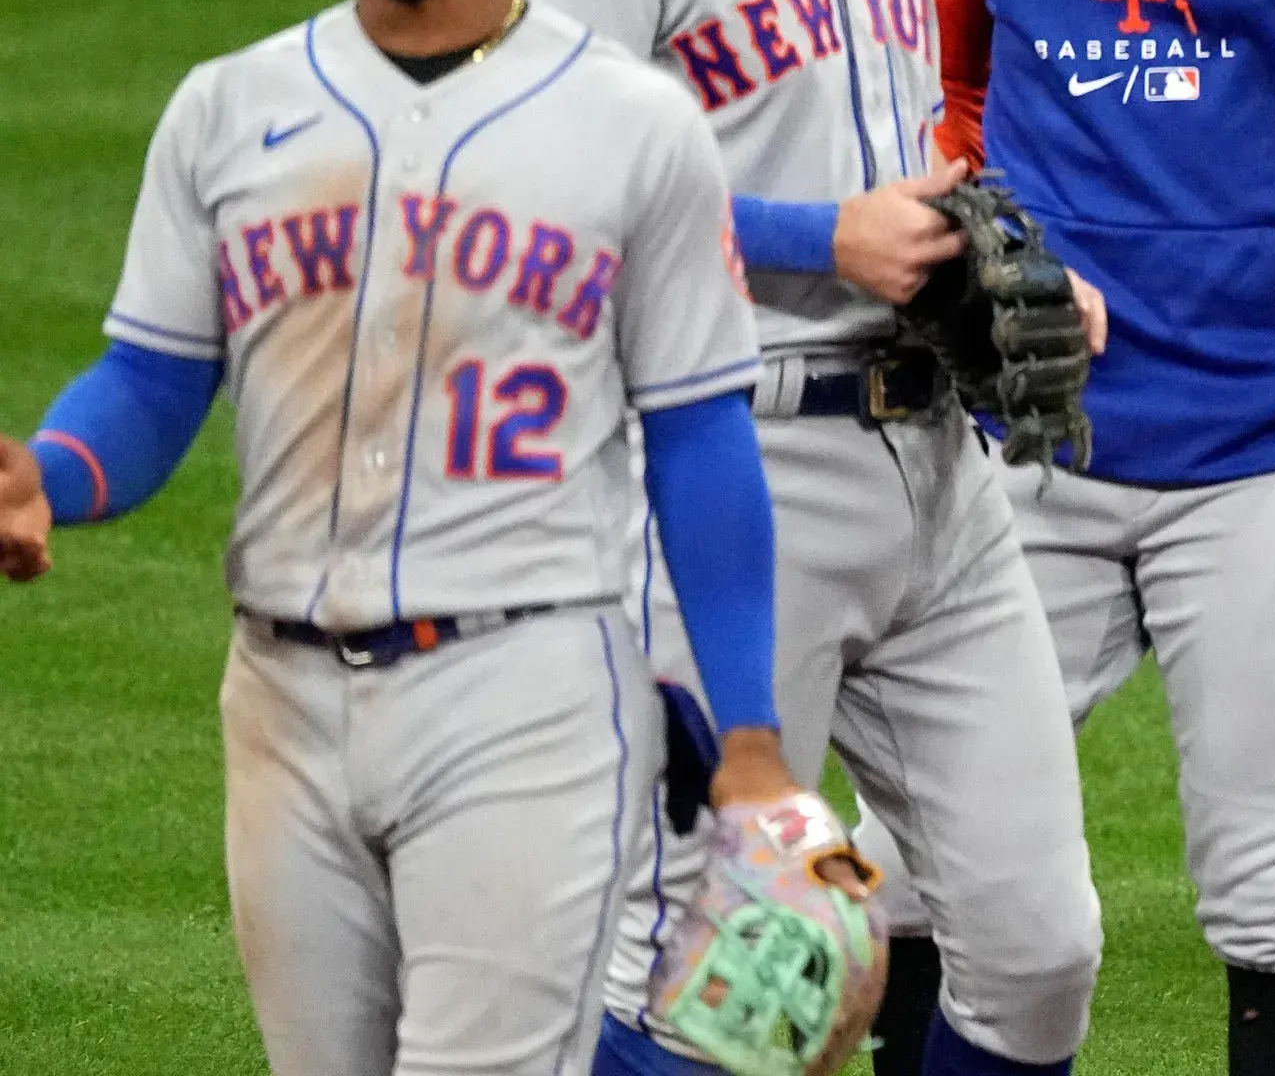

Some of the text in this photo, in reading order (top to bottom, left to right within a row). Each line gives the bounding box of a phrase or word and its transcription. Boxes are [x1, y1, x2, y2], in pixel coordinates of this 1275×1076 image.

[1033, 37, 1236, 62] BASEBALL
[219, 191, 624, 341] NEW YORK
[444, 355, 570, 483] 12
